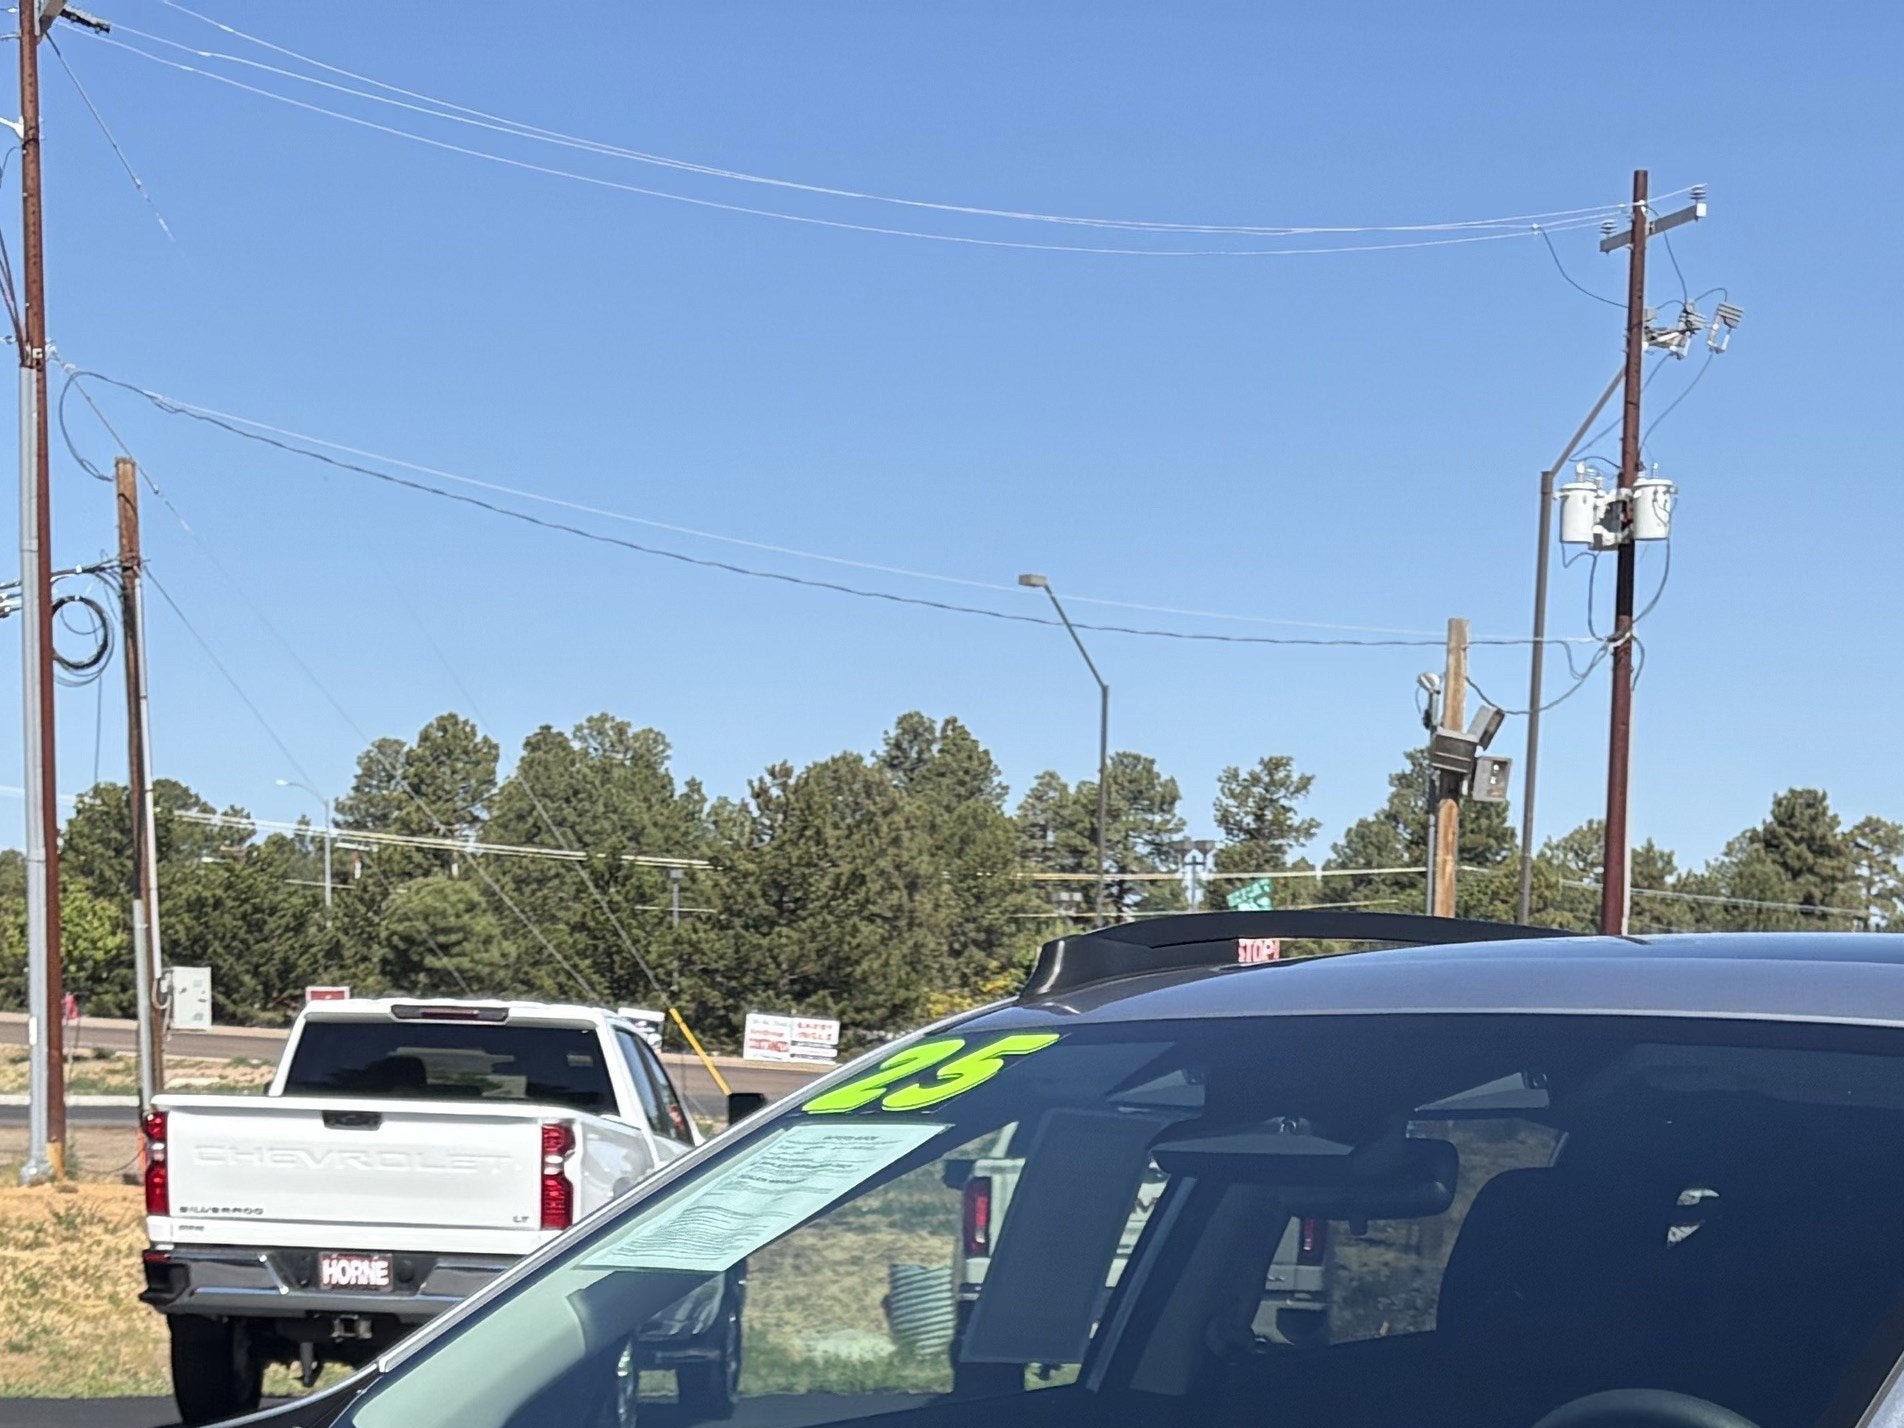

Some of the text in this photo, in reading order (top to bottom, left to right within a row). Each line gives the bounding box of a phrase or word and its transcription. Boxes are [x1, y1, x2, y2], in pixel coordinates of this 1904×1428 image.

[802, 1034, 1059, 1114] 25
[194, 1145, 514, 1175] CHEVROLET
[322, 1259, 389, 1287] HORNE
